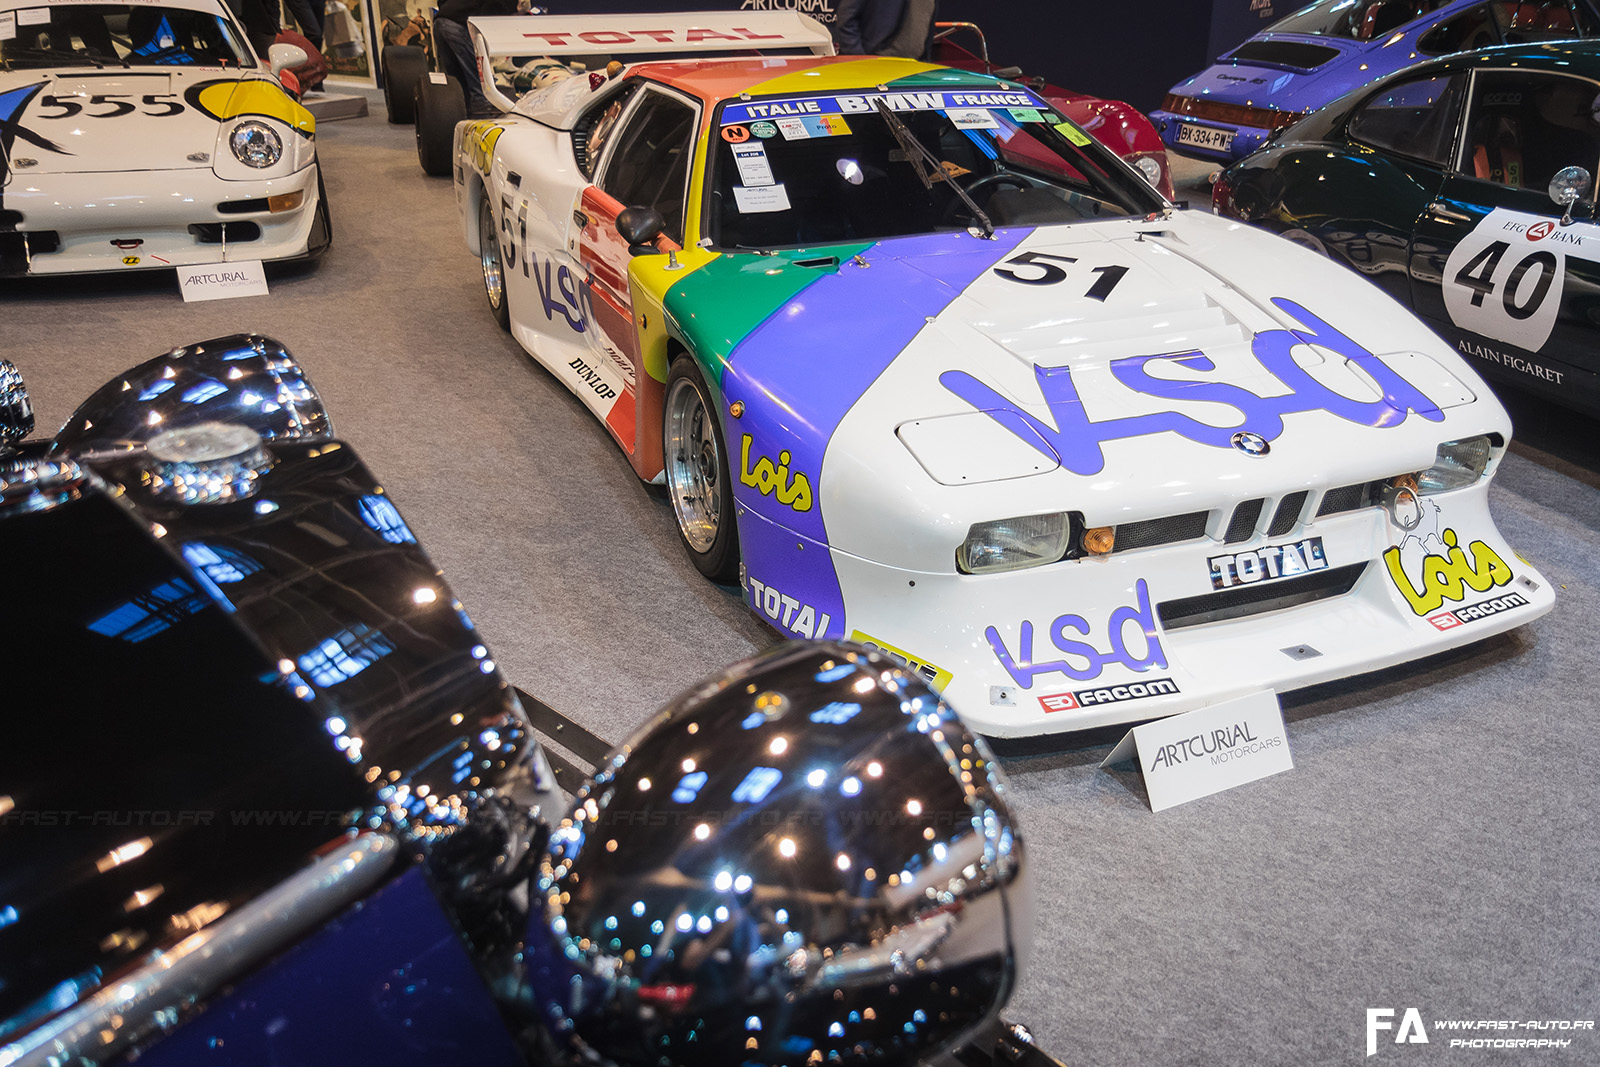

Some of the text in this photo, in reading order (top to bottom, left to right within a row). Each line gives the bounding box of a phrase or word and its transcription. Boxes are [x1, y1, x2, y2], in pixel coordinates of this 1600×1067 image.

[522, 27, 784, 46] TOTAL
[37, 94, 185, 118] 555
[746, 93, 1033, 118] ITALIE BMW FRANCE
[727, 127, 743, 138] N
[500, 193, 530, 278] 51
[1503, 221, 1585, 246] EFG BANK
[185, 271, 249, 286] ARTCURIAL
[220, 279, 263, 288] MOTORCARS
[993, 251, 1130, 302] 51
[1454, 240, 1557, 320] 40
[1458, 339, 1564, 384] ALAIN FIGARET
[568, 357, 616, 399] DUNLOP
[739, 432, 814, 512] Lois
[1211, 540, 1328, 588] TOTAL
[1383, 528, 1514, 617] Lois
[1456, 594, 1526, 622] FACOM
[1079, 679, 1176, 705] FACOM
[1151, 721, 1258, 772] ARTCURIAL
[1210, 735, 1282, 766] MOTORCARS
